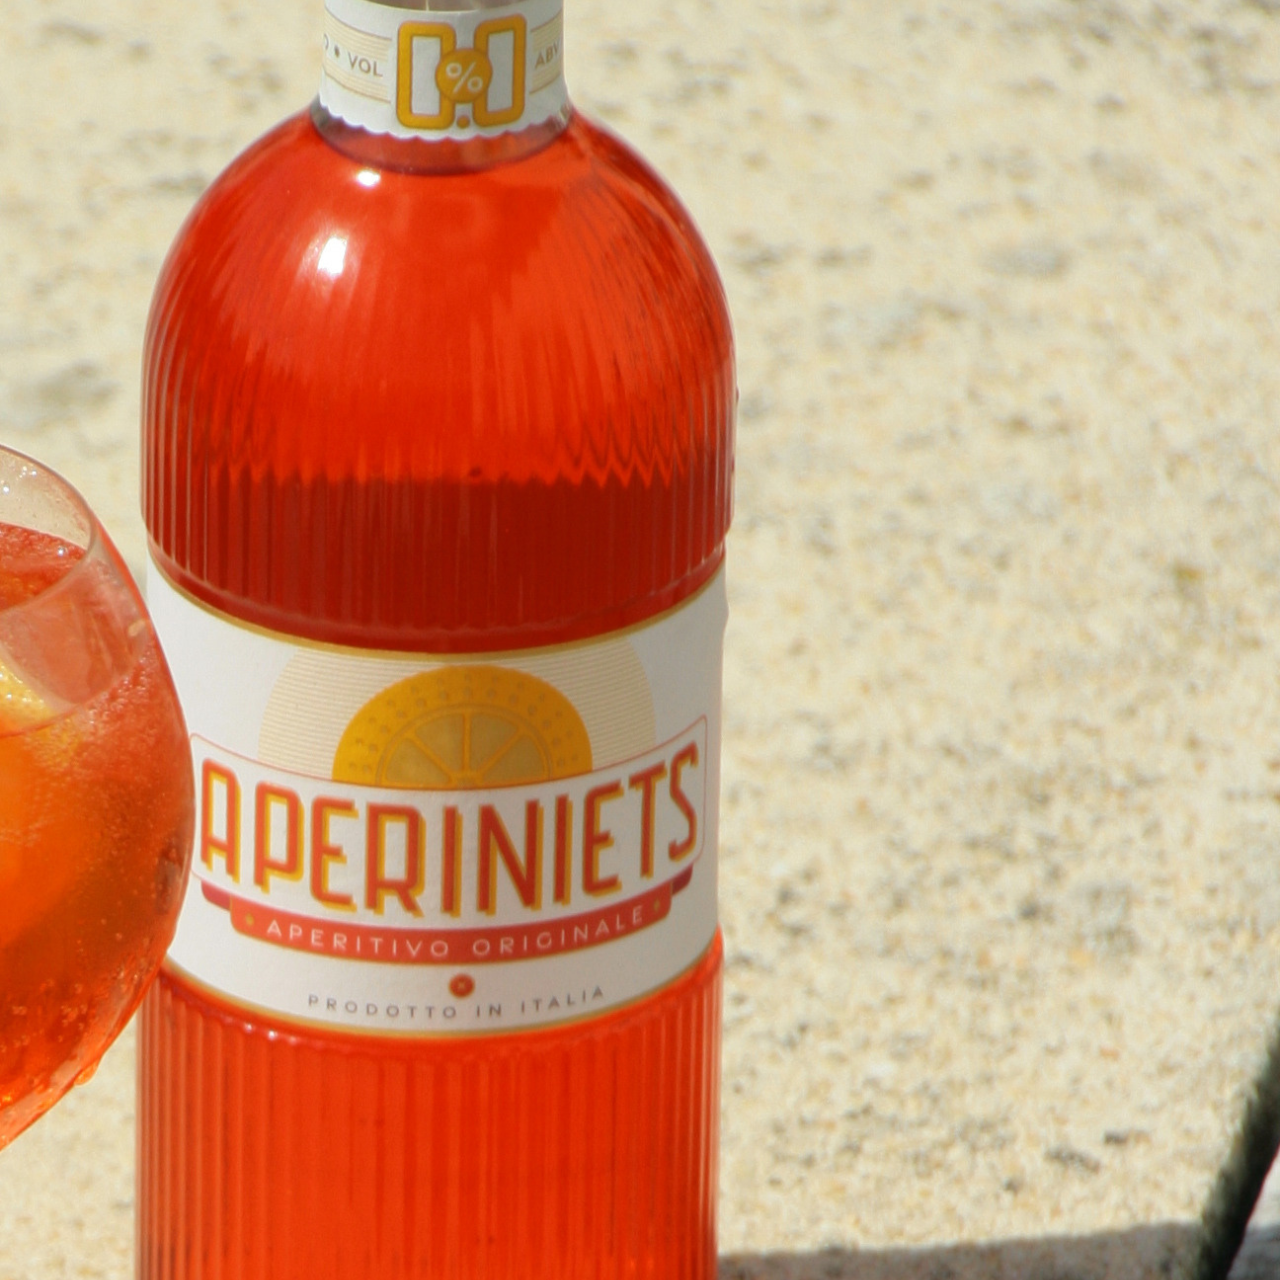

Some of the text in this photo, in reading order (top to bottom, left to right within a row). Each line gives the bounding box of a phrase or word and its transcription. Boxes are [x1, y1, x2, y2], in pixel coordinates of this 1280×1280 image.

[200, 741, 700, 918] APERINIETS
[266, 905, 644, 958] APERITIVO ORIGINALE
[307, 985, 605, 1020] PRODOTTO IN ITALIA
